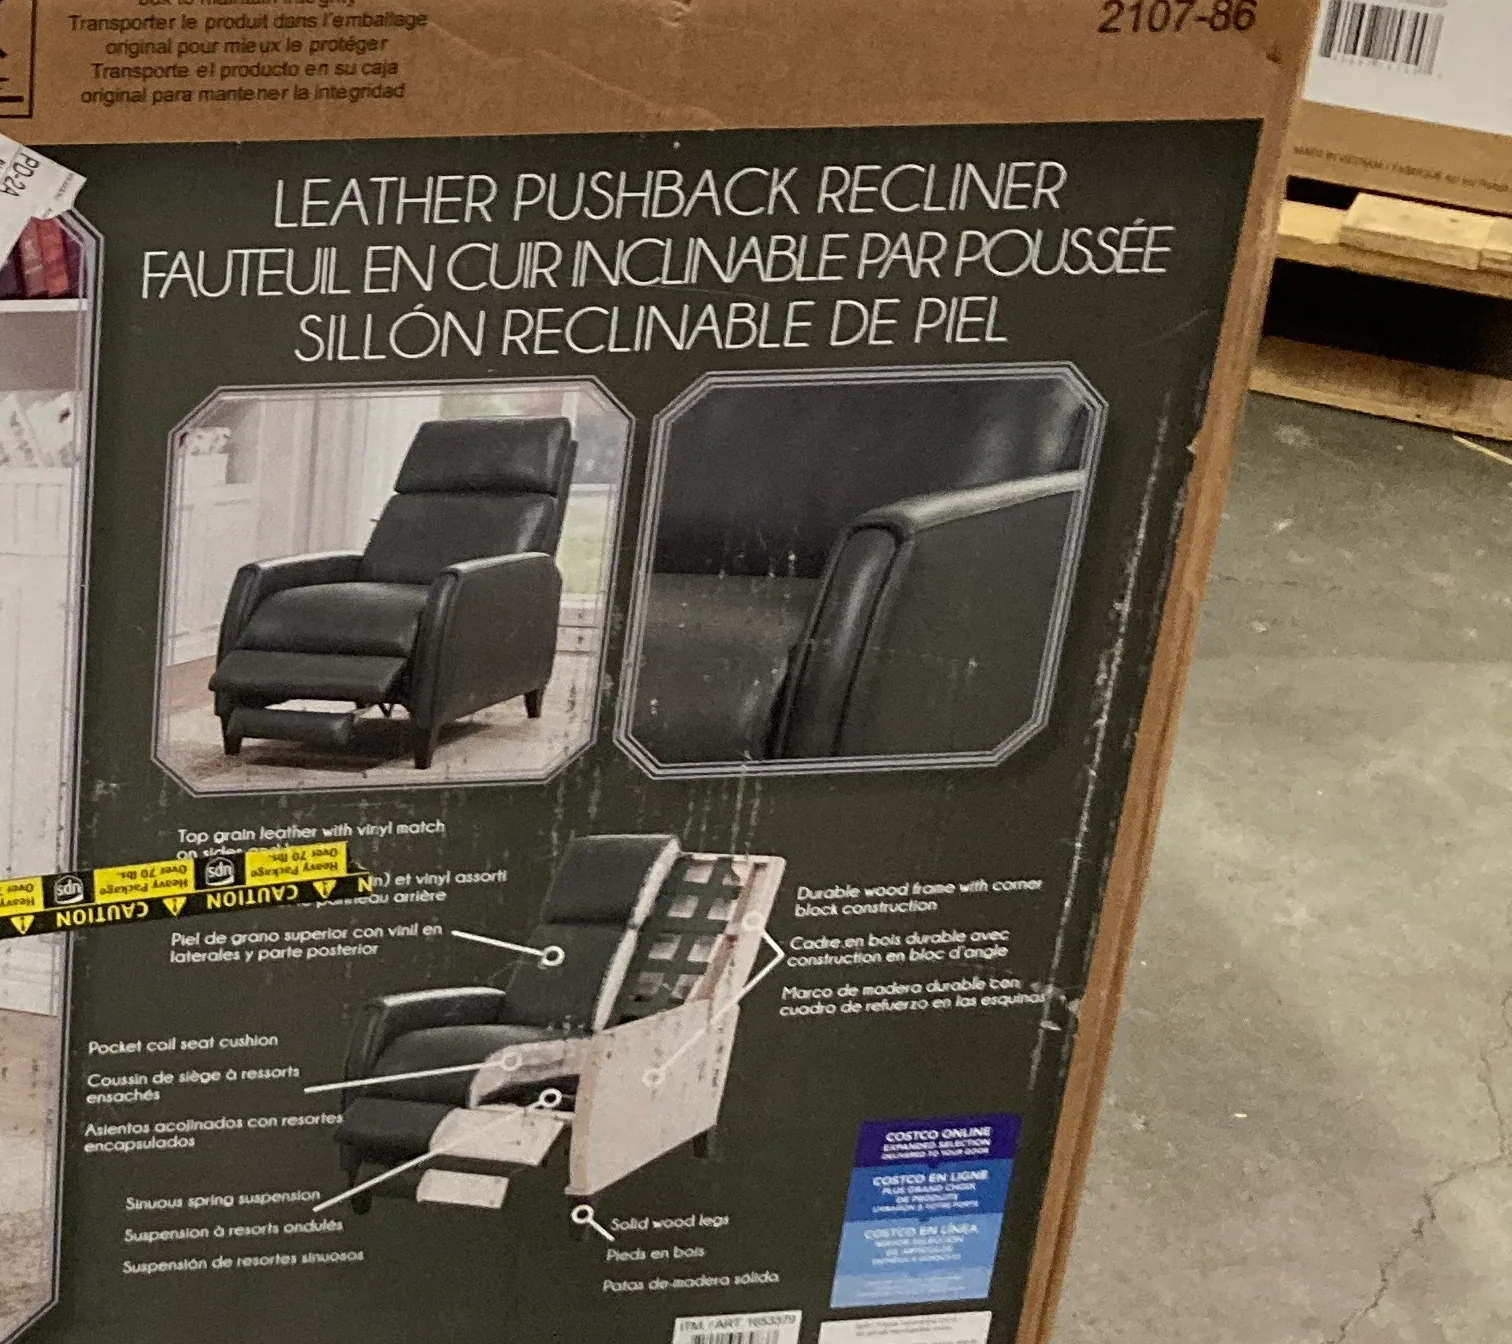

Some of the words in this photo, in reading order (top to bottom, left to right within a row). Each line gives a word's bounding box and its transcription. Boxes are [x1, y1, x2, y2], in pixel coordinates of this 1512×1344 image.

[68, 15, 176, 34] Transporter
[182, 14, 197, 30] le
[205, 13, 267, 33] produit
[273, 13, 317, 29] dans
[323, 10, 428, 31] l'emballage
[105, 39, 171, 58] original
[178, 42, 218, 58] pour
[224, 38, 281, 54] mieux
[286, 37, 301, 53] le
[309, 37, 388, 56] protéger
[92, 62, 188, 82] Transporte
[196, 62, 213, 78] el
[220, 61, 298, 81] producto
[305, 63, 327, 76] en
[334, 62, 357, 76] su
[361, 60, 398, 79] caja
[80, 87, 146, 107] original
[152, 89, 192, 106] para
[198, 87, 289, 103] mantener
[293, 85, 309, 101] la
[314, 83, 406, 103] integridad
[274, 174, 499, 229] LEATHER
[513, 166, 800, 222] PUSHBACK
[817, 161, 1068, 213] RECLINER
[141, 246, 352, 300] FAUTEUIL
[363, 244, 436, 294] EN
[446, 240, 563, 292] CUIR
[571, 233, 849, 288] INCLINABLE
[857, 230, 947, 280] PAR
[955, 217, 1176, 278] POUSSÉE
[294, 304, 487, 362] SILLÓN
[502, 300, 816, 356] RECLINABLE
[830, 297, 901, 346] DE
[914, 295, 1008, 344] PIEL
[178, 829, 208, 845] Top
[213, 829, 255, 845] grain
[260, 826, 316, 842] leather
[322, 824, 352, 839] with
[357, 822, 392, 839] vinyl
[397, 820, 445, 835] match
[99, 880, 148, 897] Package
[152, 876, 188, 890] Heavy
[395, 873, 411, 887] et
[417, 871, 450, 887] vinyl
[456, 870, 507, 884] assorti
[206, 884, 298, 910] CAUTION
[394, 889, 447, 903] arrière
[797, 886, 860, 900] Durable
[864, 882, 908, 897] wood
[912, 882, 955, 896] frame
[959, 880, 988, 893] with
[56, 901, 148, 927] CAUTION
[795, 904, 837, 917] block
[842, 900, 937, 915] construction
[171, 932, 199, 947] Piel
[205, 931, 226, 945] de
[230, 933, 279, 947] grano
[285, 927, 348, 945] superior
[352, 926, 383, 939] con
[388, 923, 418, 937] vinil
[423, 925, 442, 936] en
[170, 948, 240, 963] laterales
[245, 950, 254, 962] y
[259, 946, 302, 962] parte
[307, 943, 379, 960] posterior
[782, 986, 832, 1000] Marco
[837, 984, 858, 997] de
[863, 982, 922, 996] madera
[926, 976, 986, 993] durable
[88, 1040, 141, 1055] Pocket
[147, 1037, 176, 1051] coil
[180, 1037, 214, 1050] seat
[219, 1034, 278, 1049] cushion
[88, 1072, 148, 1088] Coussin
[152, 1071, 175, 1085] de
[179, 1069, 221, 1085] siège
[225, 1067, 237, 1080] à
[242, 1065, 300, 1080] ressorts
[86, 1088, 160, 1104] ensachés
[85, 1122, 150, 1137] Asientos
[155, 1116, 243, 1133] acojinados
[247, 1116, 277, 1128] con
[282, 1112, 343, 1126] resortes
[885, 1130, 938, 1142] COSTCO
[942, 1126, 991, 1139] ONLINE
[84, 1136, 195, 1153] encapsulados
[873, 1174, 926, 1187] COSTCO
[929, 1172, 946, 1183] EN
[126, 1197, 182, 1211] Sinuous
[188, 1194, 234, 1210] spring
[239, 1190, 320, 1206] suspension
[610, 1217, 649, 1231] Solid
[653, 1215, 695, 1229] wood
[699, 1213, 729, 1227] legs
[606, 1247, 645, 1262] Pieds
[650, 1248, 669, 1260] en
[674, 1245, 705, 1258] bois
